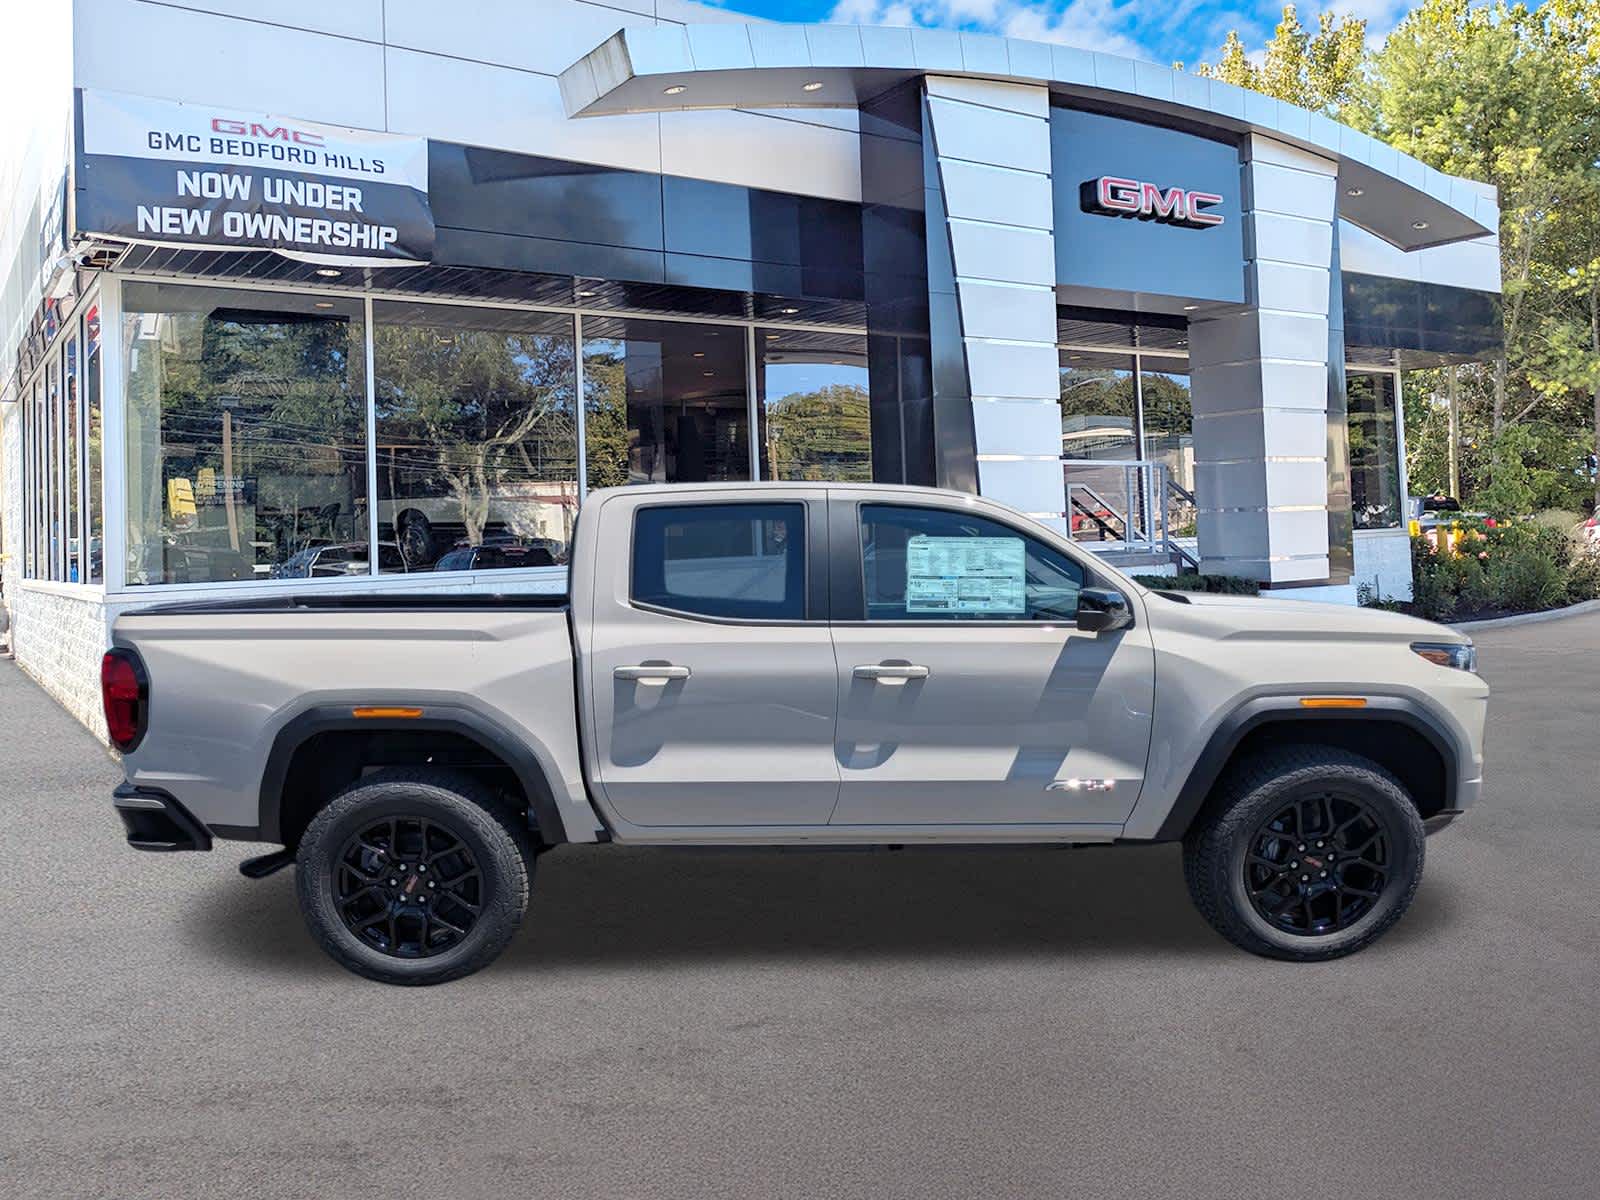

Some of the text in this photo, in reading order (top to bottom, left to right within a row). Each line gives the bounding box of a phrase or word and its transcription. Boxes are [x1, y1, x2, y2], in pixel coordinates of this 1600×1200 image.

[148, 131, 385, 174] GMC BEDFORD HILLS
[210, 118, 326, 148] GMC
[176, 170, 364, 213] NOW UNDER
[1097, 175, 1225, 225] GMC
[136, 205, 398, 250] NEW OWNERSHIP
